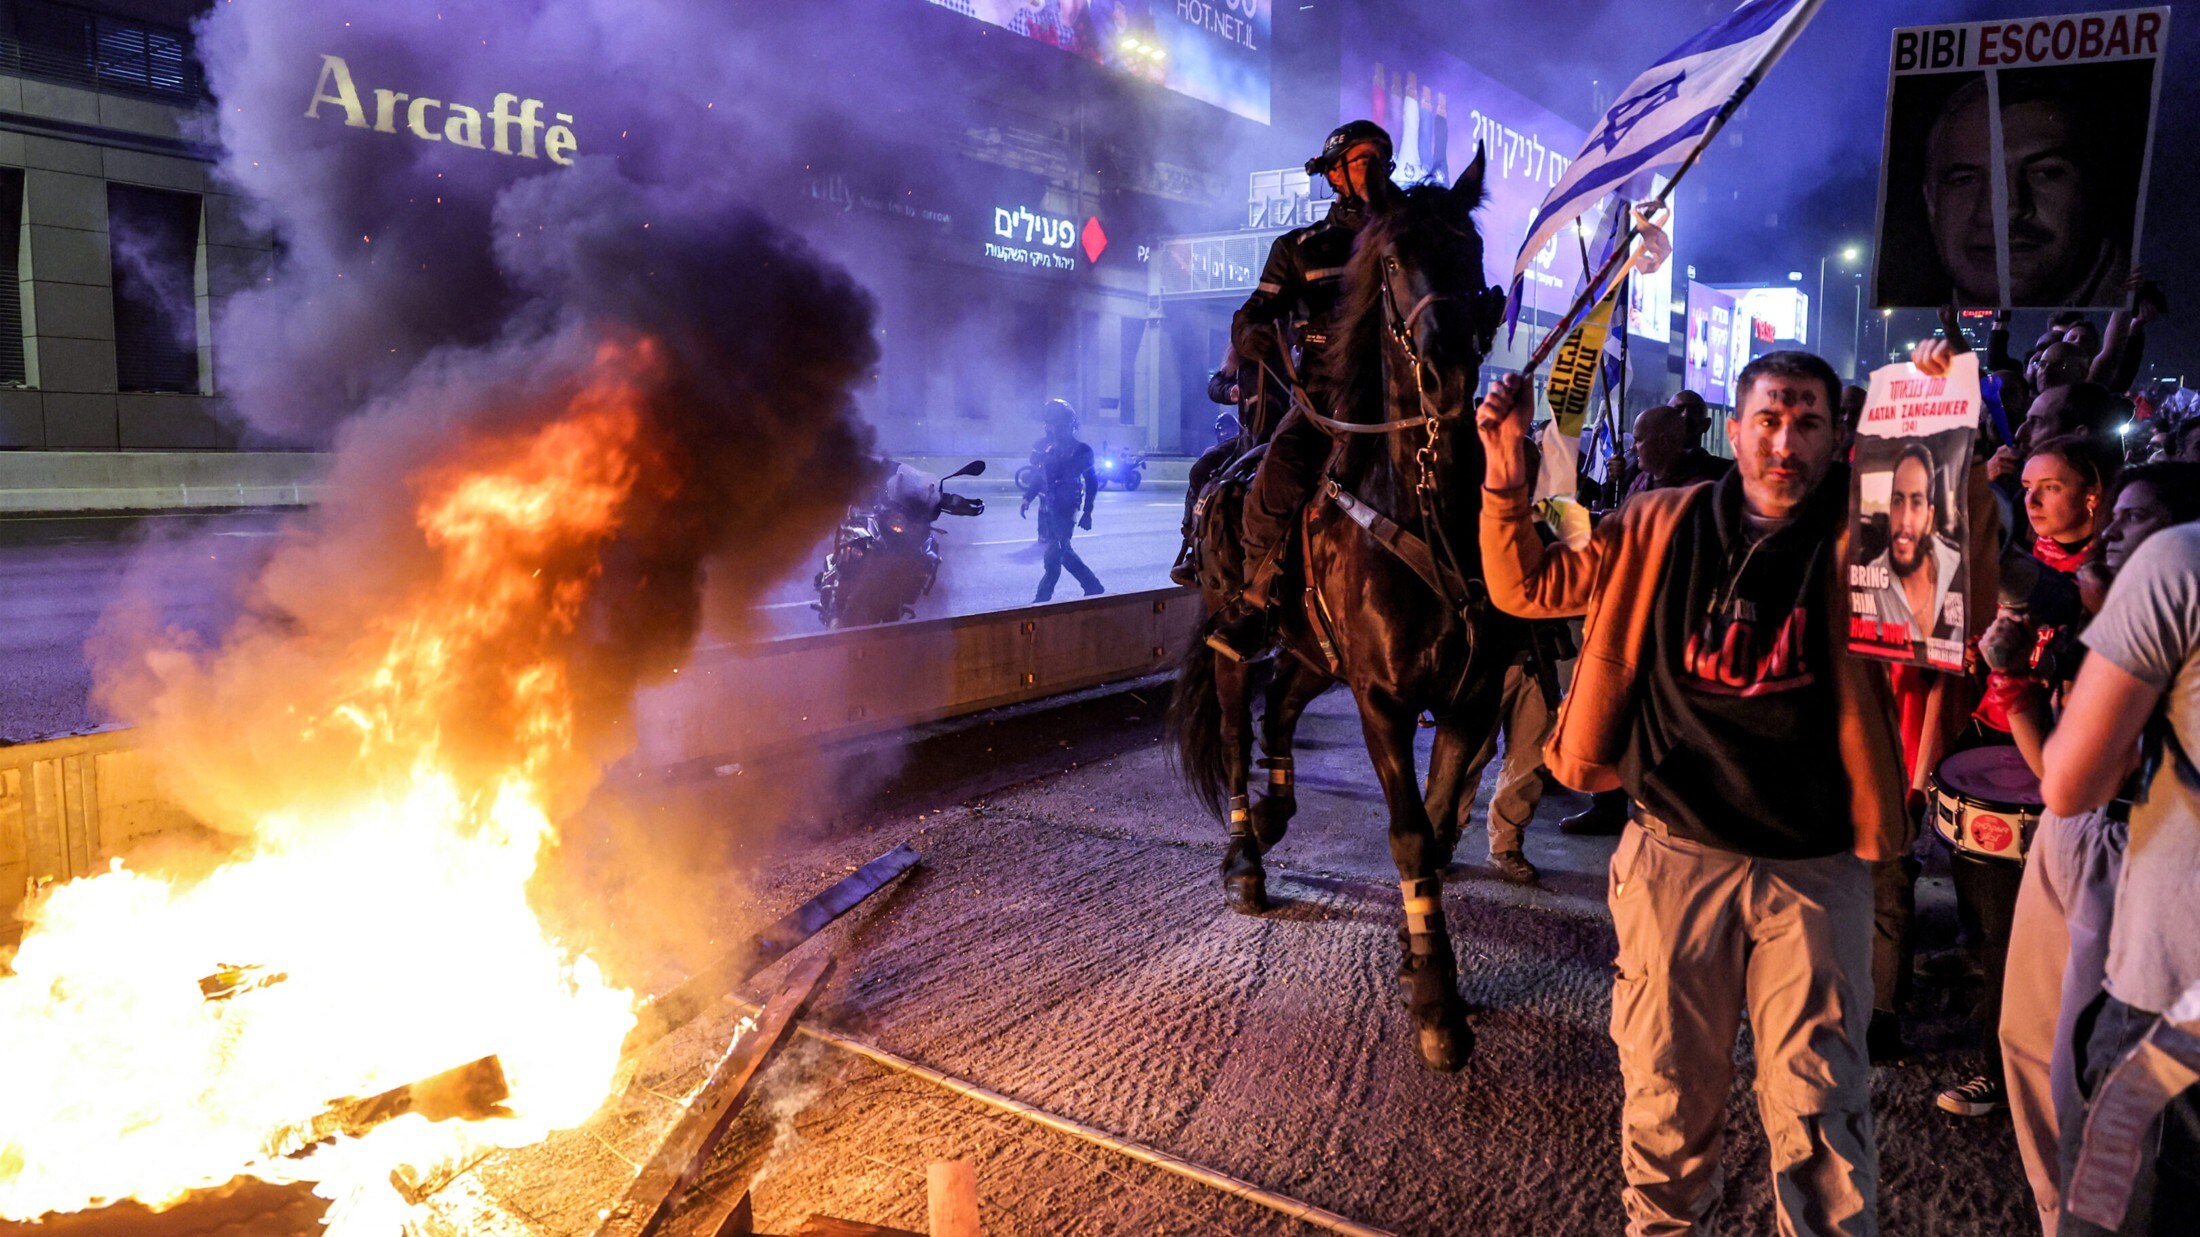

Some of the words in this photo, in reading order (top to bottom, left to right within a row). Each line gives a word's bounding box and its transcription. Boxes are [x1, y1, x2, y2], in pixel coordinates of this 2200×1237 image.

[1895, 28, 1967, 71] BIBI
[1978, 12, 2162, 66] ESCOBAR
[994, 205, 1076, 249] פעילים
[985, 242, 1028, 263] השקעות
[1902, 400, 1969, 418] ZANGAUKER
[1902, 420, 1918, 433] (24)
[1850, 564, 1889, 589] BRING
[1851, 591, 1878, 615] HIM
[1849, 616, 1878, 640] HOME
